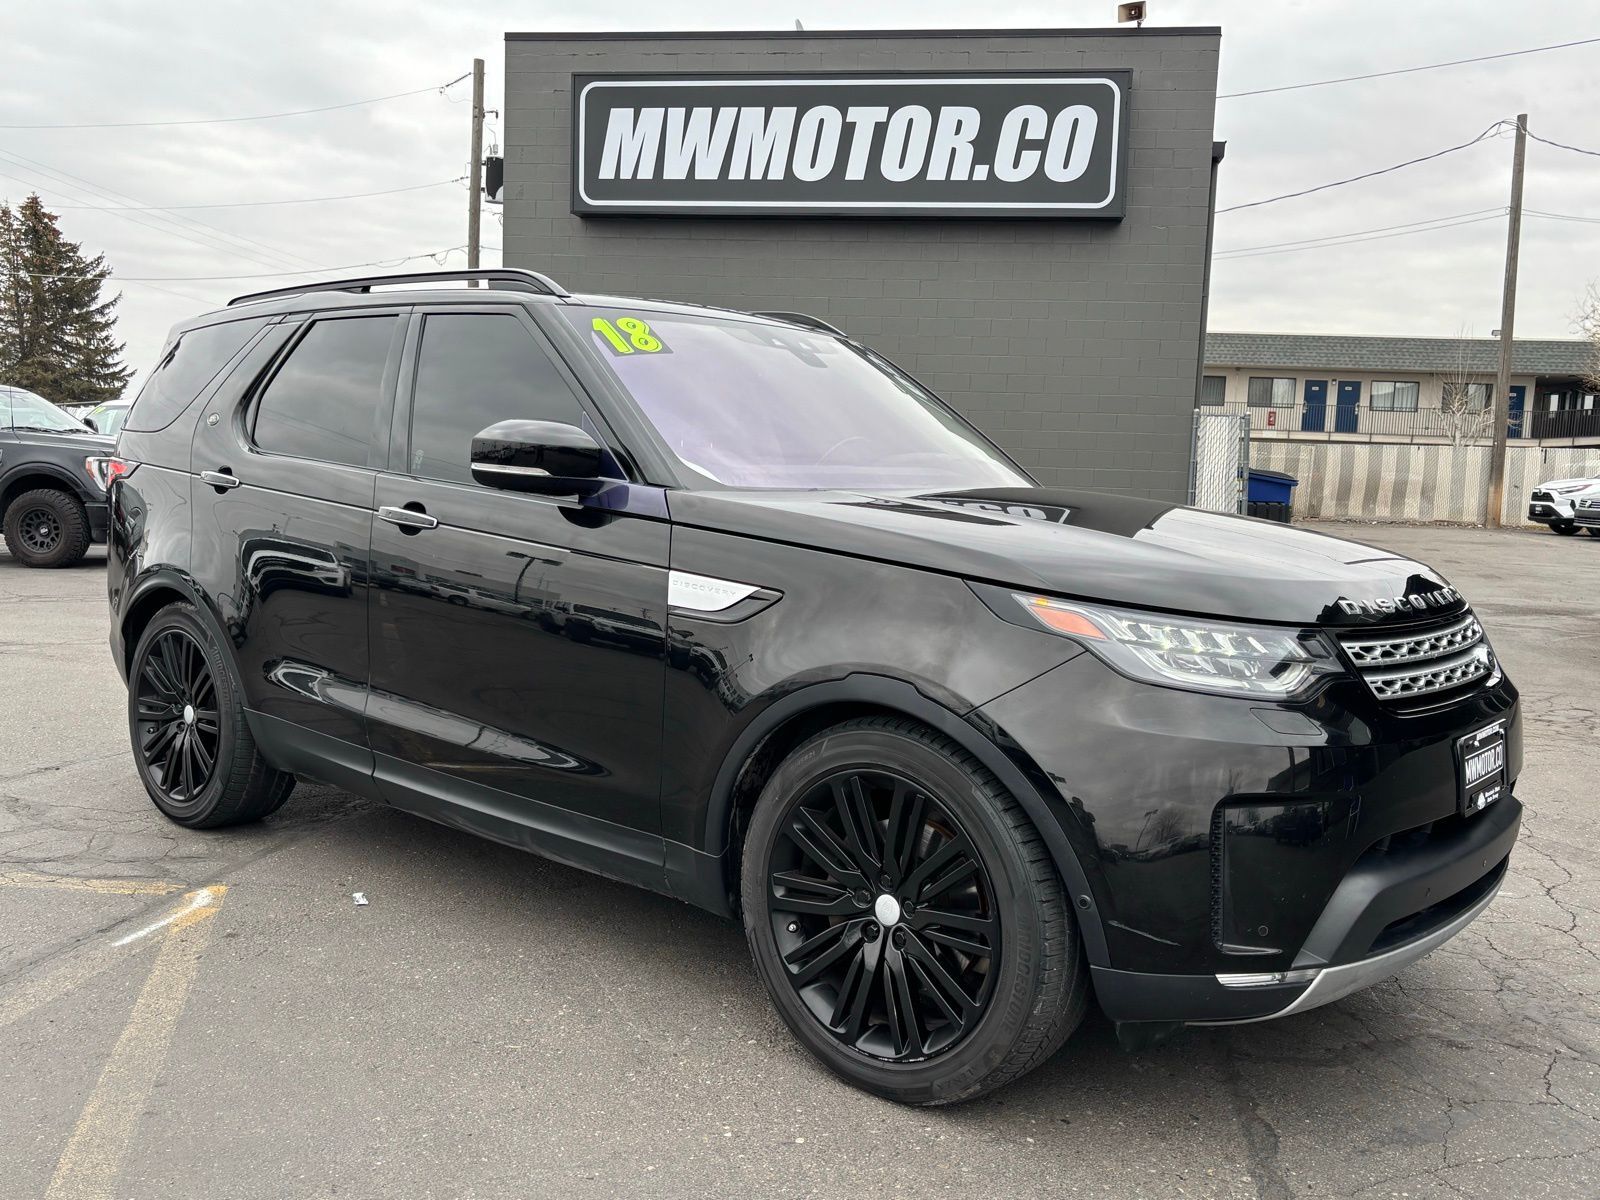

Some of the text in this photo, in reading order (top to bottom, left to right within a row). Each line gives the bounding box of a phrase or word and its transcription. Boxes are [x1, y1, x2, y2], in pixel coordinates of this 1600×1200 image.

[598, 104, 1099, 183] MWMOTOR.CO
[591, 317, 663, 354] 18
[672, 579, 736, 597] DISCOVERY
[1465, 744, 1503, 784] MWMOTOR.CO
